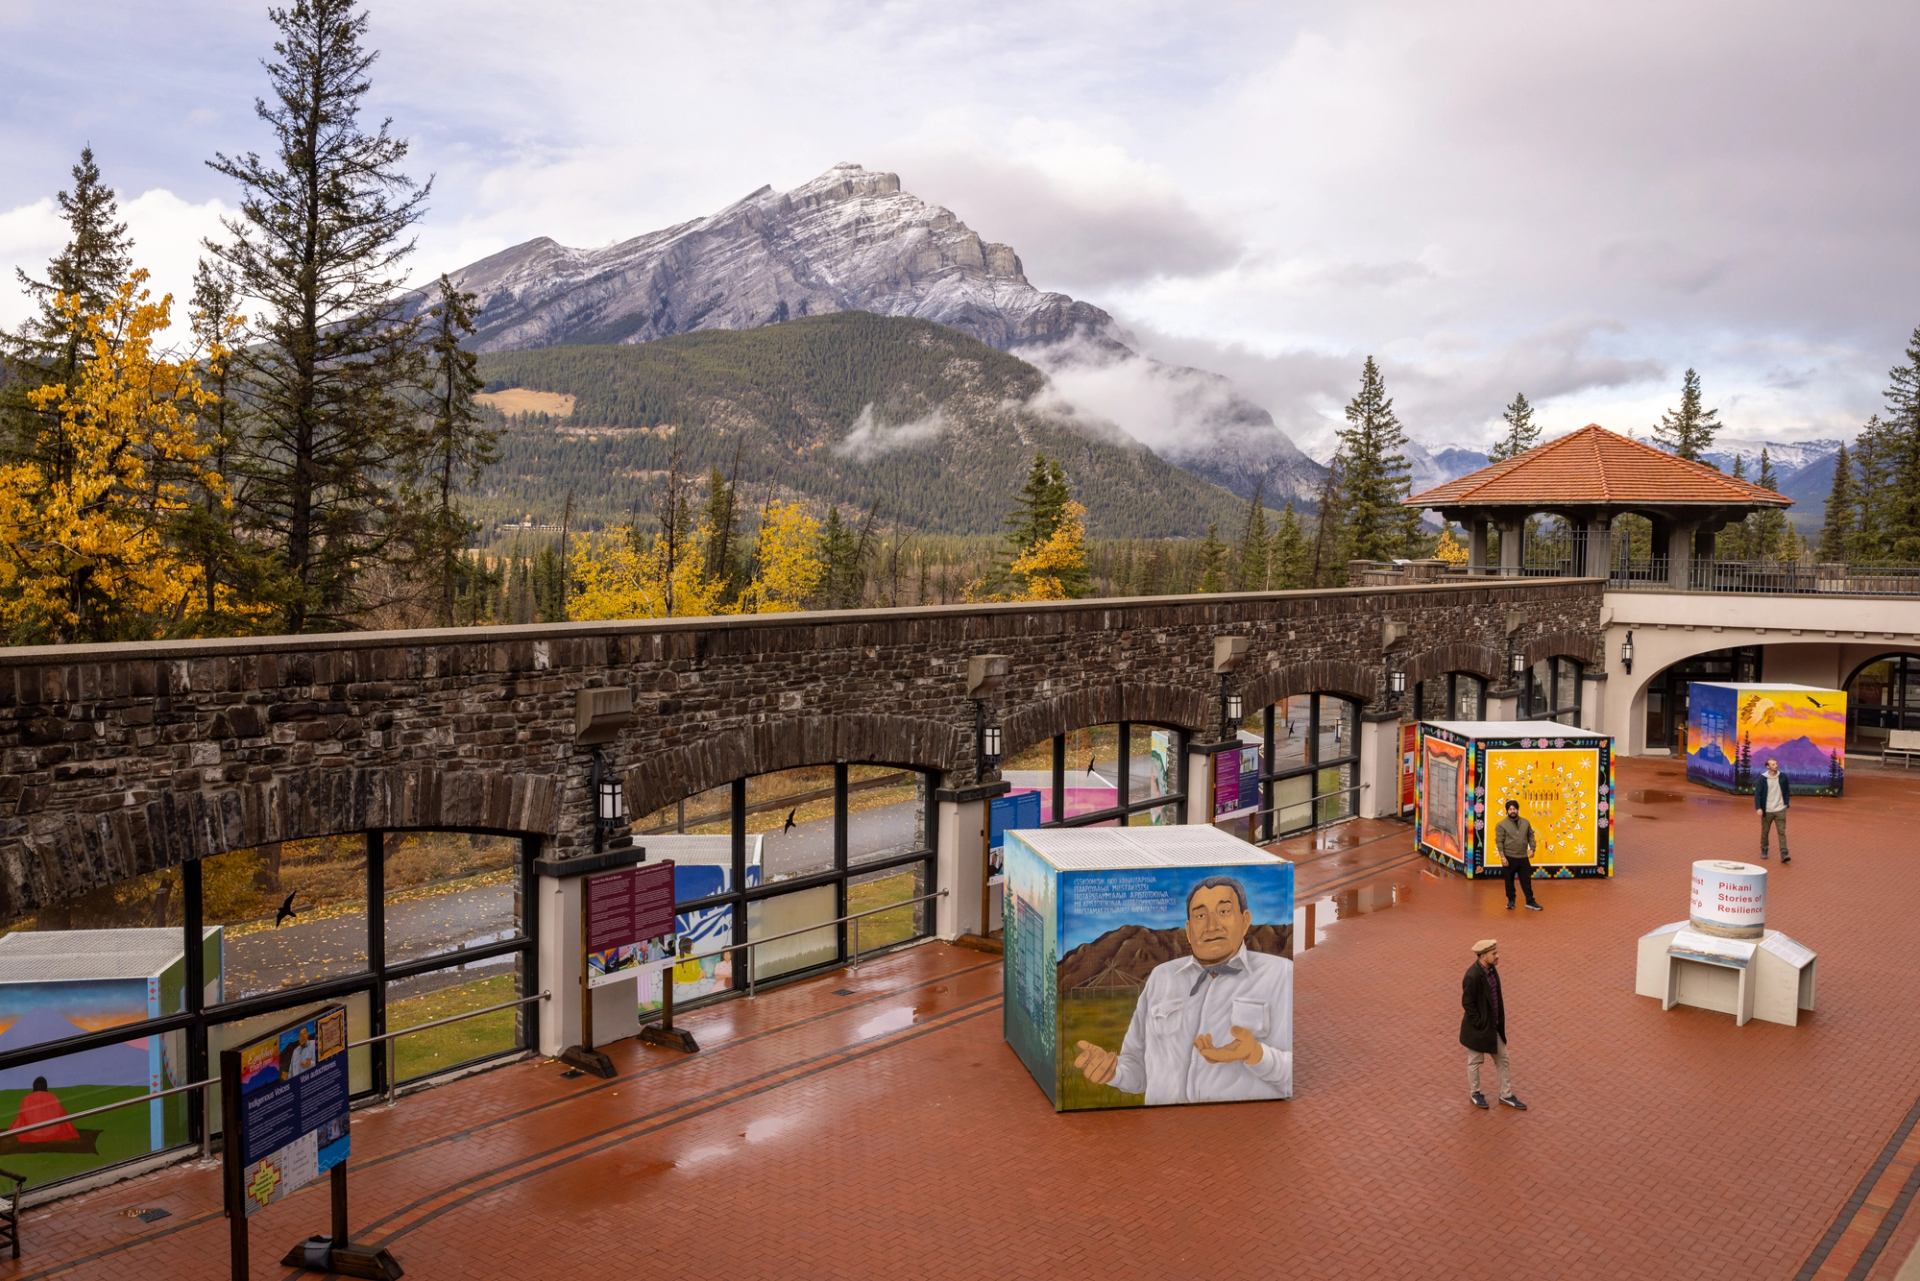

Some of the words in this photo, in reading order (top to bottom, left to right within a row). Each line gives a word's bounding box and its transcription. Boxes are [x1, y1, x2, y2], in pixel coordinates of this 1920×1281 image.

[1719, 882, 1752, 892] Piikani
[1718, 893, 1753, 903] Stories
[300, 1073, 310, 1083] Voix
[248, 1092, 275, 1109] Indigenous
[275, 1083, 291, 1096] Voices
